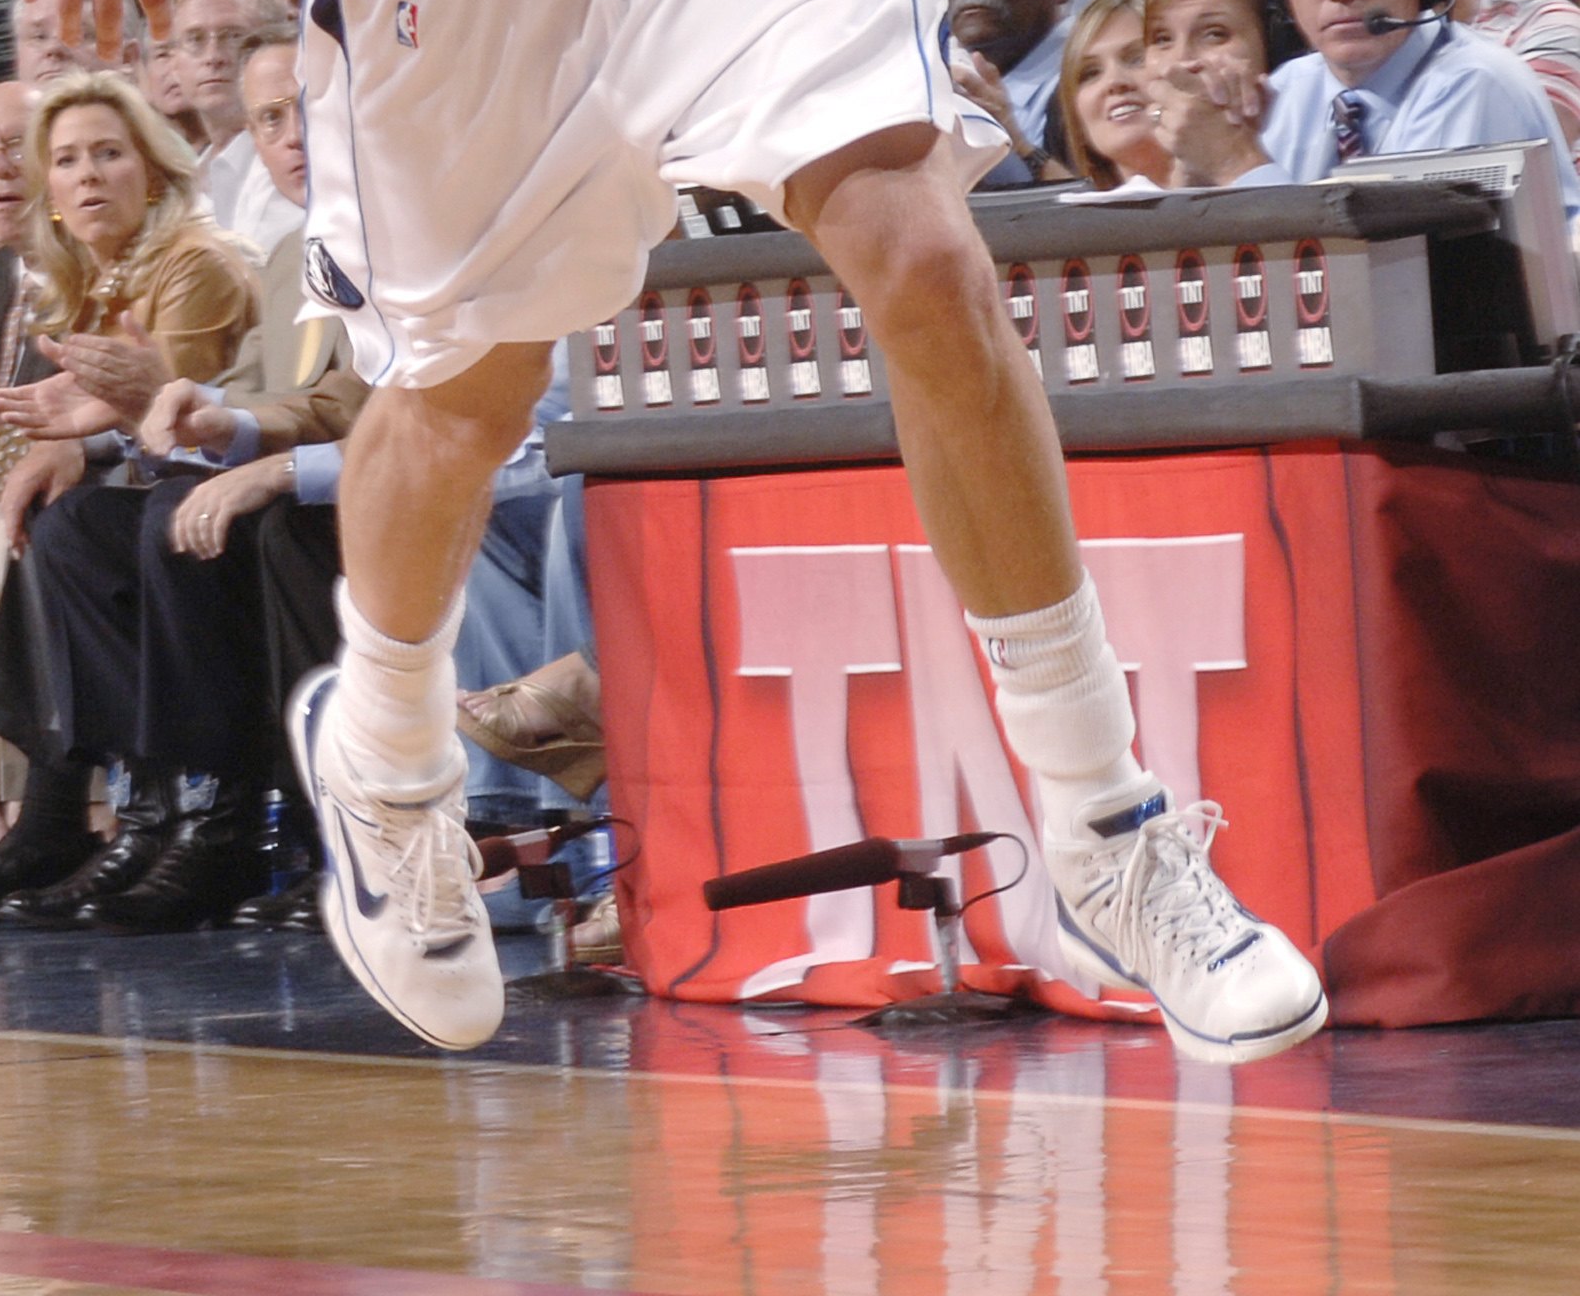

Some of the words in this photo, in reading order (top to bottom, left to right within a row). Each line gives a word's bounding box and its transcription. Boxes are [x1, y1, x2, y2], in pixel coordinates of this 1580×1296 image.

[1176, 281, 1204, 304] TNT
[1234, 275, 1262, 298] TNT
[1295, 270, 1323, 294] TNT
[1008, 295, 1033, 319] TNT
[1063, 290, 1089, 313] TNT
[1119, 286, 1145, 309] TNT
[687, 317, 711, 339] TNT
[738, 316, 760, 337] TNT
[789, 309, 811, 331] TNT
[838, 307, 861, 329] TNT
[594, 324, 615, 345] TNT
[640, 320, 663, 341] TNT
[730, 533, 1248, 1004] TNT
